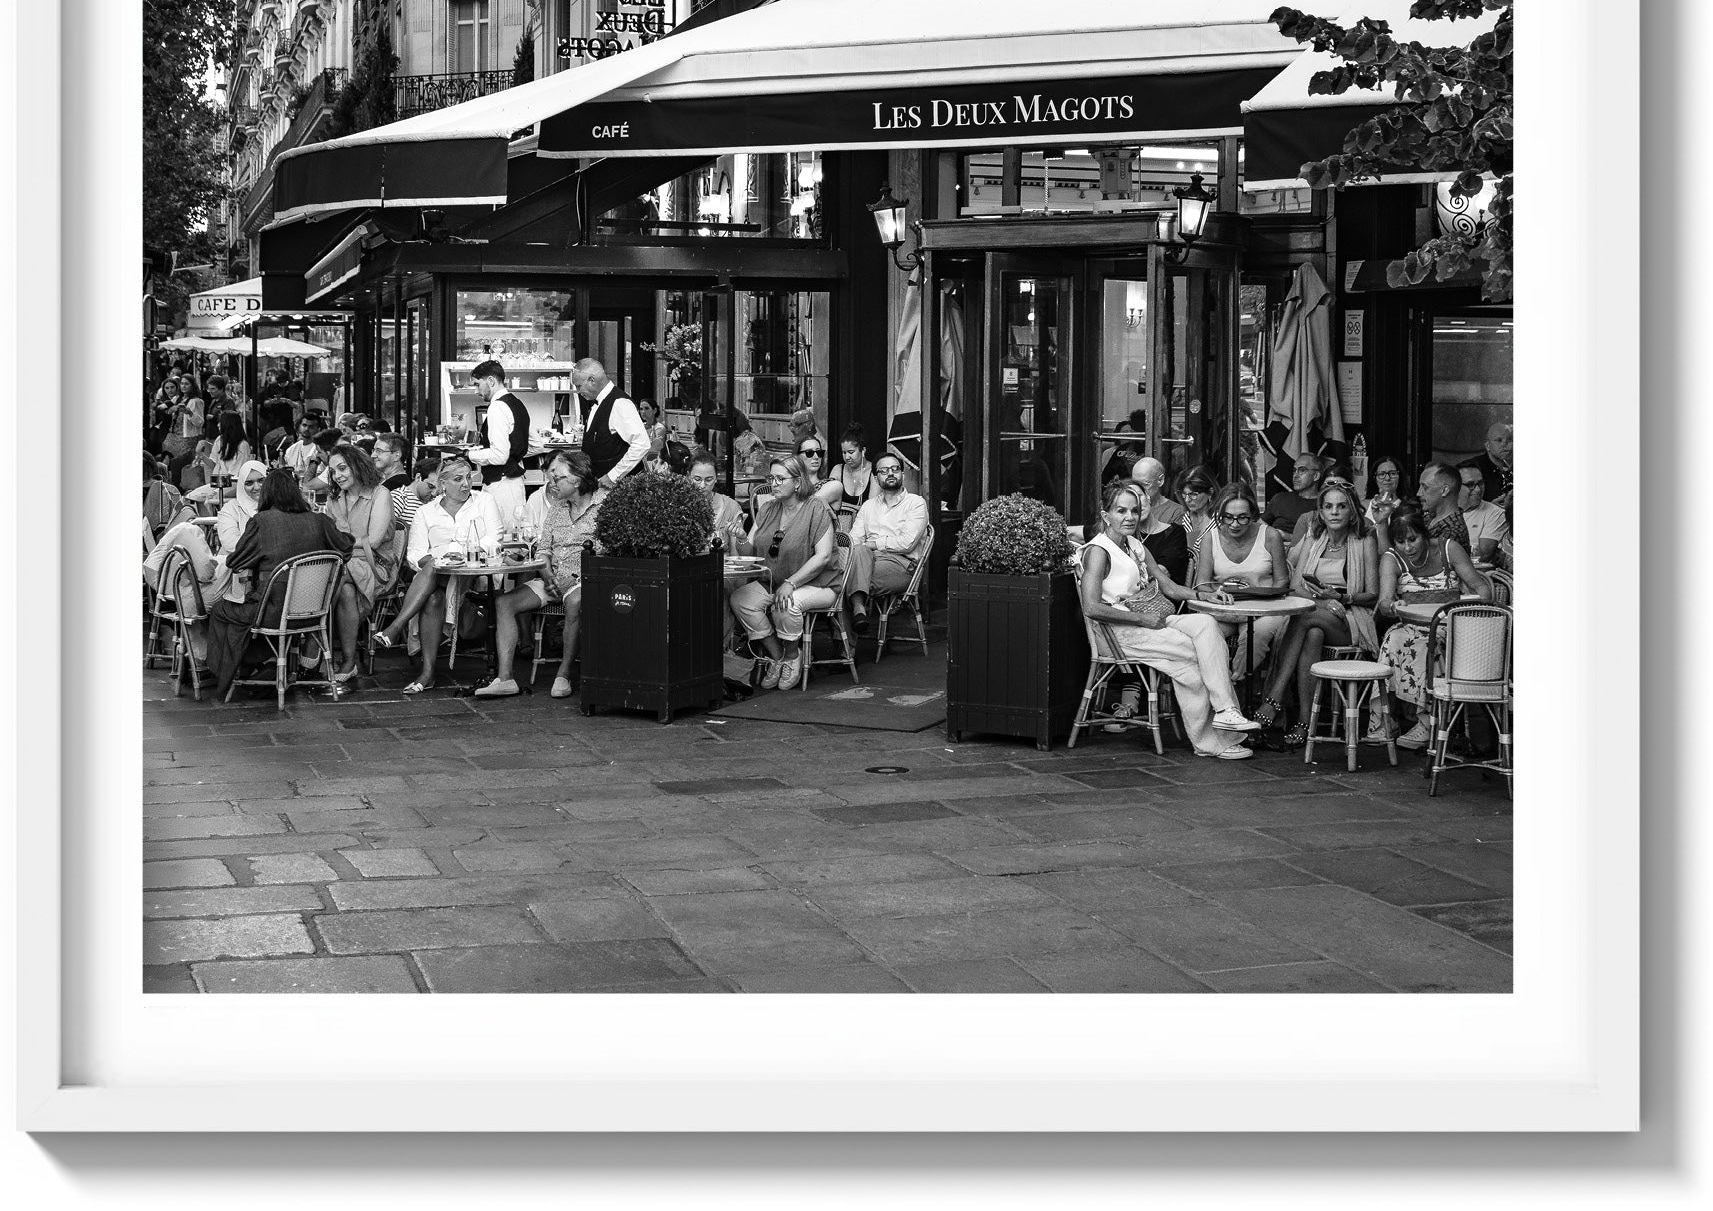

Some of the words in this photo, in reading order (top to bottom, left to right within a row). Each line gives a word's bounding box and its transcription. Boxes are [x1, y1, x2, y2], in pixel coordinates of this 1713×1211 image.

[872, 102, 921, 130] LES
[931, 98, 1006, 128] DEUX
[1012, 94, 1134, 124] MAGOTS
[592, 121, 629, 138] CAFÉ
[198, 298, 236, 311] CAFE
